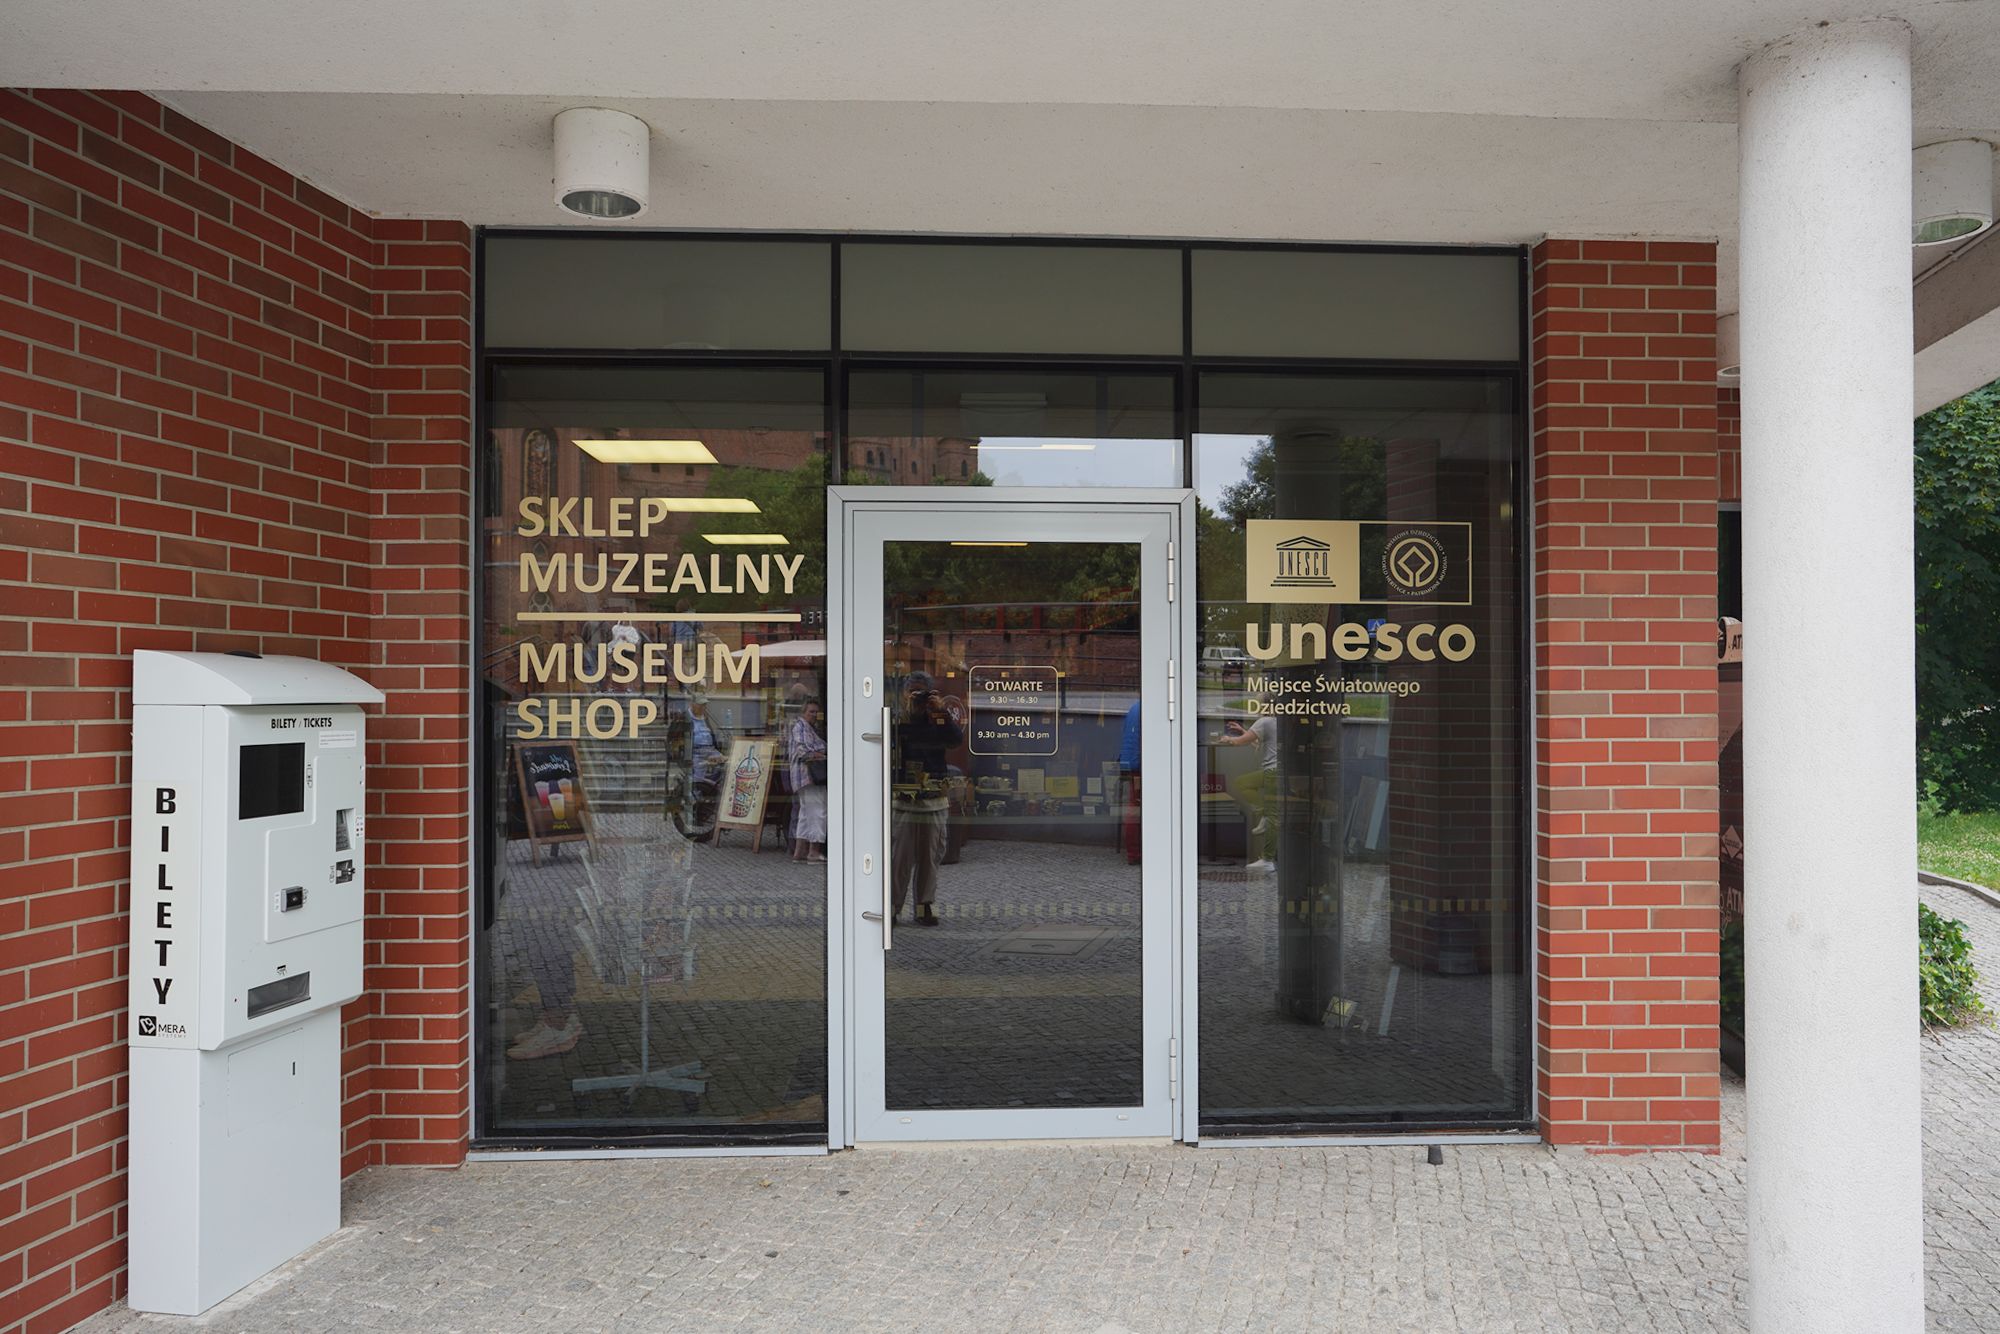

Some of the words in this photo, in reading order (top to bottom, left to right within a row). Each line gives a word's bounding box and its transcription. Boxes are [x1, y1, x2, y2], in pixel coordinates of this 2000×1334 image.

[518, 496, 668, 538] SKLEP
[519, 552, 805, 594] MUZEALNY
[1279, 551, 1328, 576] UNESCO
[1246, 622, 1476, 662] unesco
[519, 642, 760, 684] MUSEUM
[985, 681, 1043, 692] OTWARTE
[1246, 677, 1312, 696] Miejsce
[1315, 674, 1421, 697] Światowego
[516, 698, 658, 739] SHOP
[1246, 699, 1351, 716] Dziedzictwa
[271, 718, 297, 729] BILETY
[304, 717, 332, 728] TICKETS
[997, 716, 1030, 726] OPEN
[152, 788, 176, 1004] BILETY
[158, 1024, 186, 1034] MERA
